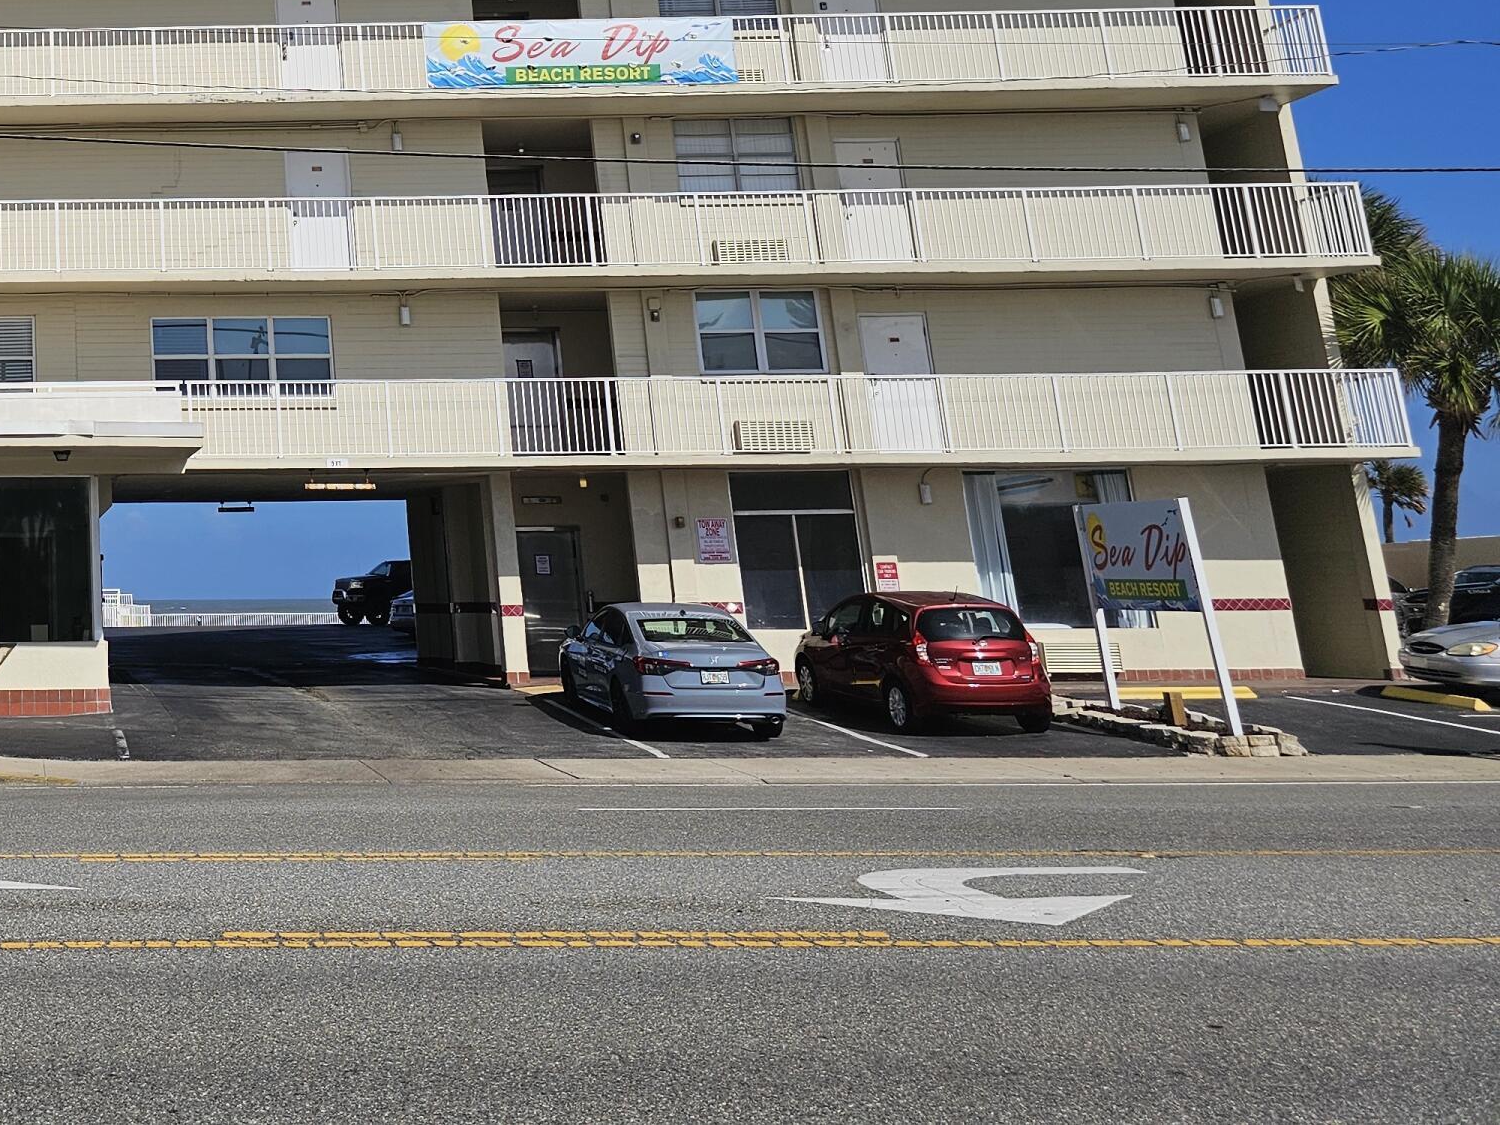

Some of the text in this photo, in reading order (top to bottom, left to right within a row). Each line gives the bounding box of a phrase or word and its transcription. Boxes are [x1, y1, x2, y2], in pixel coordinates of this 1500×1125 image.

[491, 23, 670, 65] Sea Dip
[515, 66, 651, 82] BEACH RESORT
[706, 527, 720, 537] ZONE
[1091, 523, 1186, 581] Sea Dip
[1108, 581, 1181, 597] BEACH RESORT
